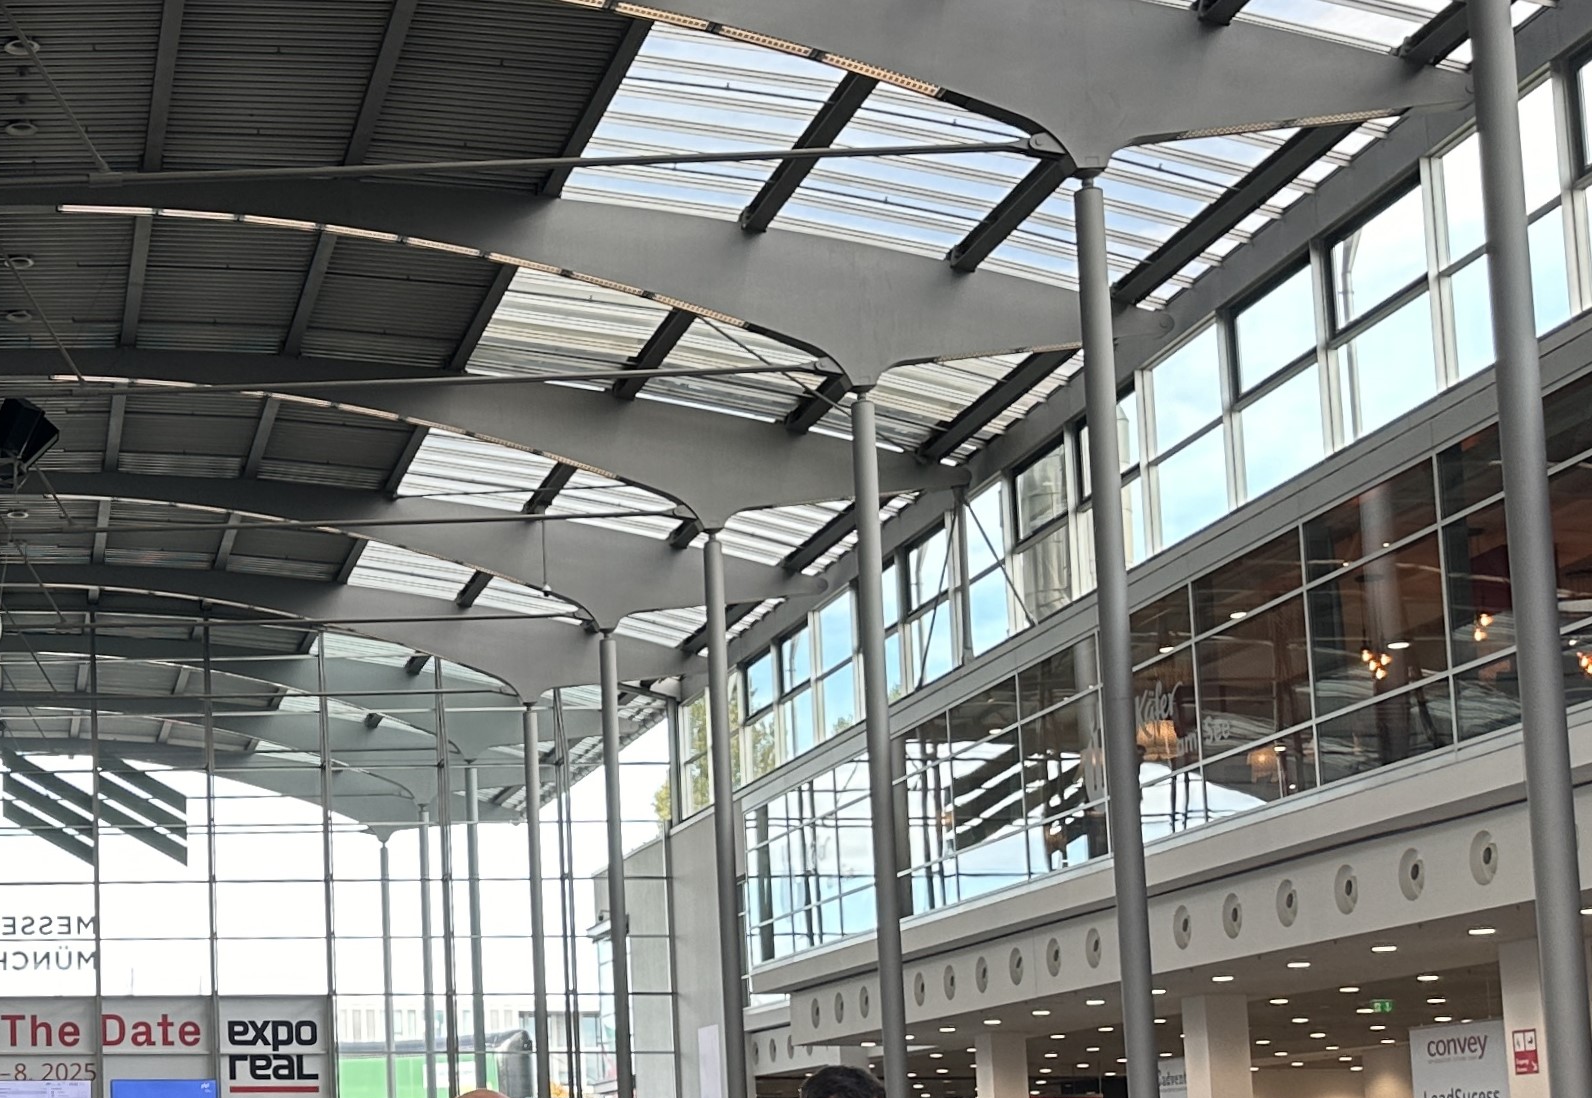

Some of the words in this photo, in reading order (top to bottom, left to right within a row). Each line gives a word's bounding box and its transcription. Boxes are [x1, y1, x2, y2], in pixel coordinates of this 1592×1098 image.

[1202, 716, 1230, 745] See
[1, 1015, 80, 1047] The
[101, 1014, 201, 1046] Date
[228, 1020, 317, 1051] expo
[1427, 1035, 1488, 1060] convey
[41, 1063, 97, 1081] 2025
